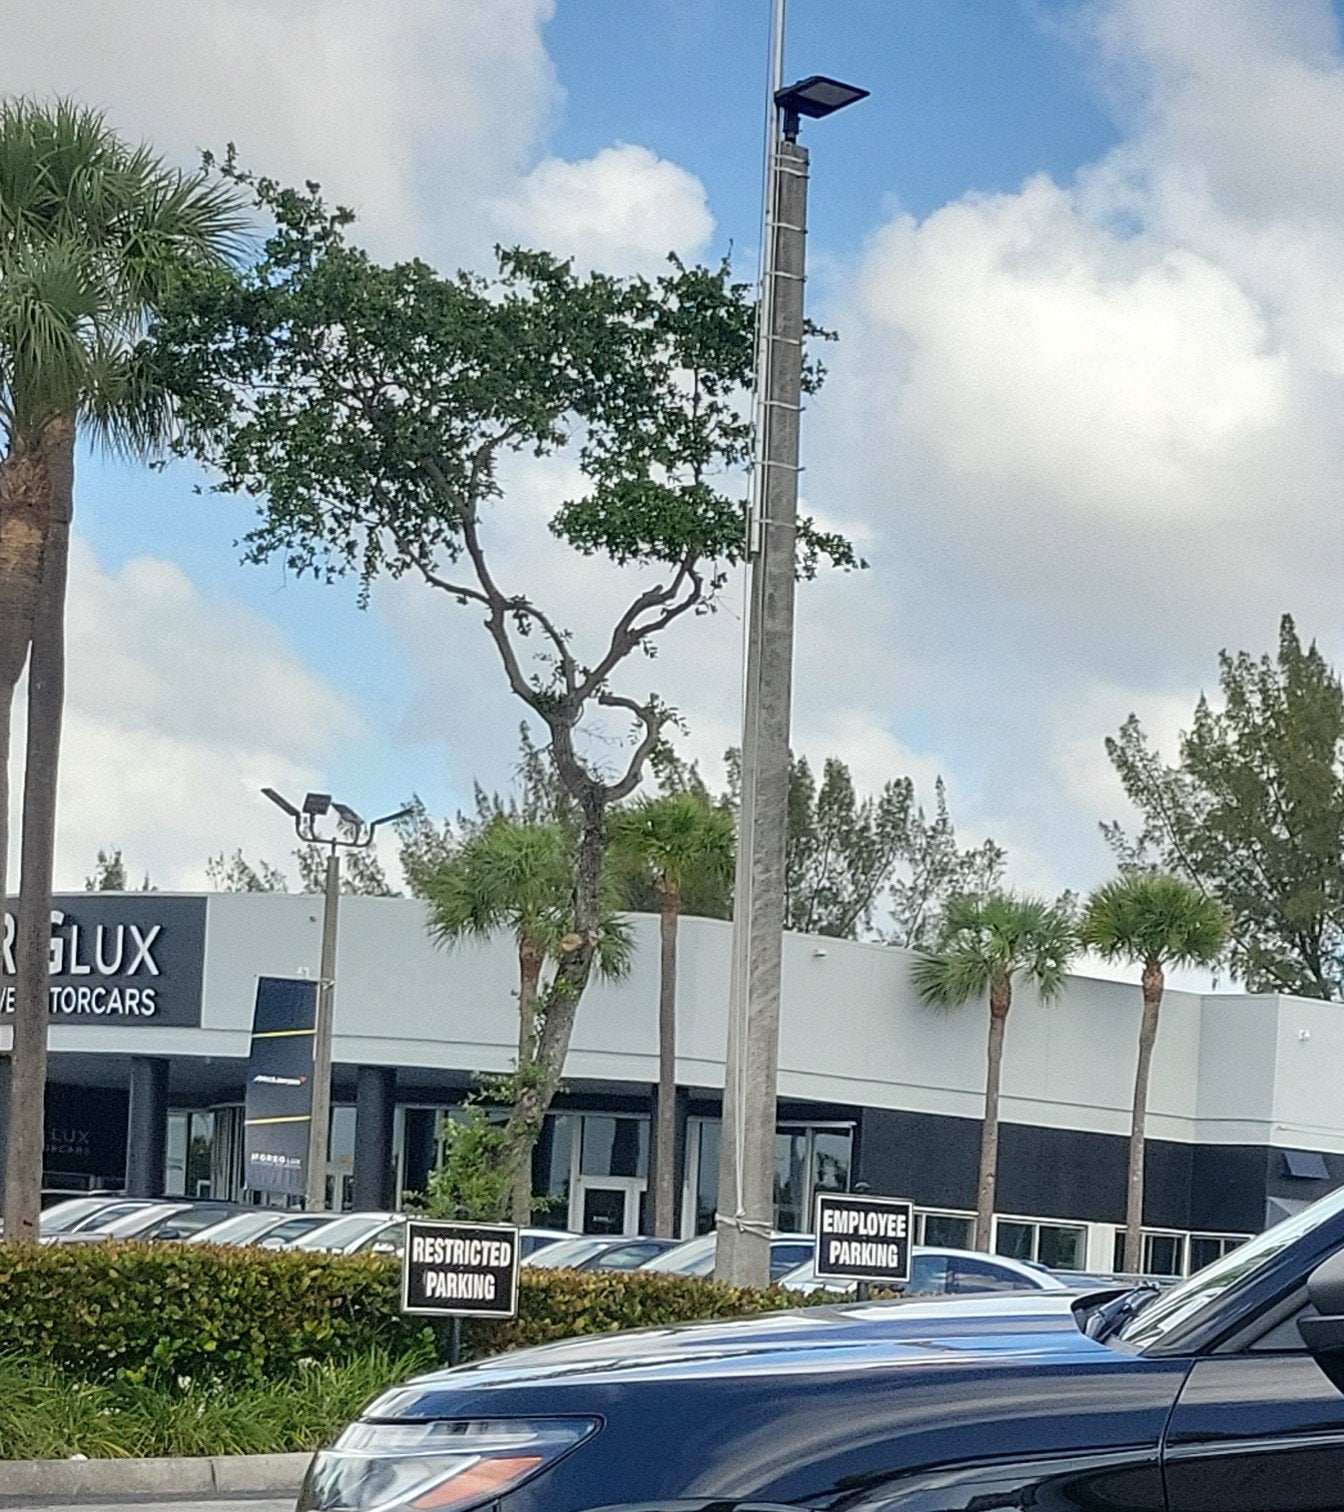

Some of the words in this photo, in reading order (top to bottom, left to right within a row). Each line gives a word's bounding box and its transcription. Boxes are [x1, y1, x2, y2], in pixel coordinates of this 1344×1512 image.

[823, 1209, 906, 1238] EMPLOYEE
[412, 1236, 511, 1268] RESTRICTED
[829, 1240, 898, 1268] PARKING
[425, 1271, 495, 1300] PARKING
